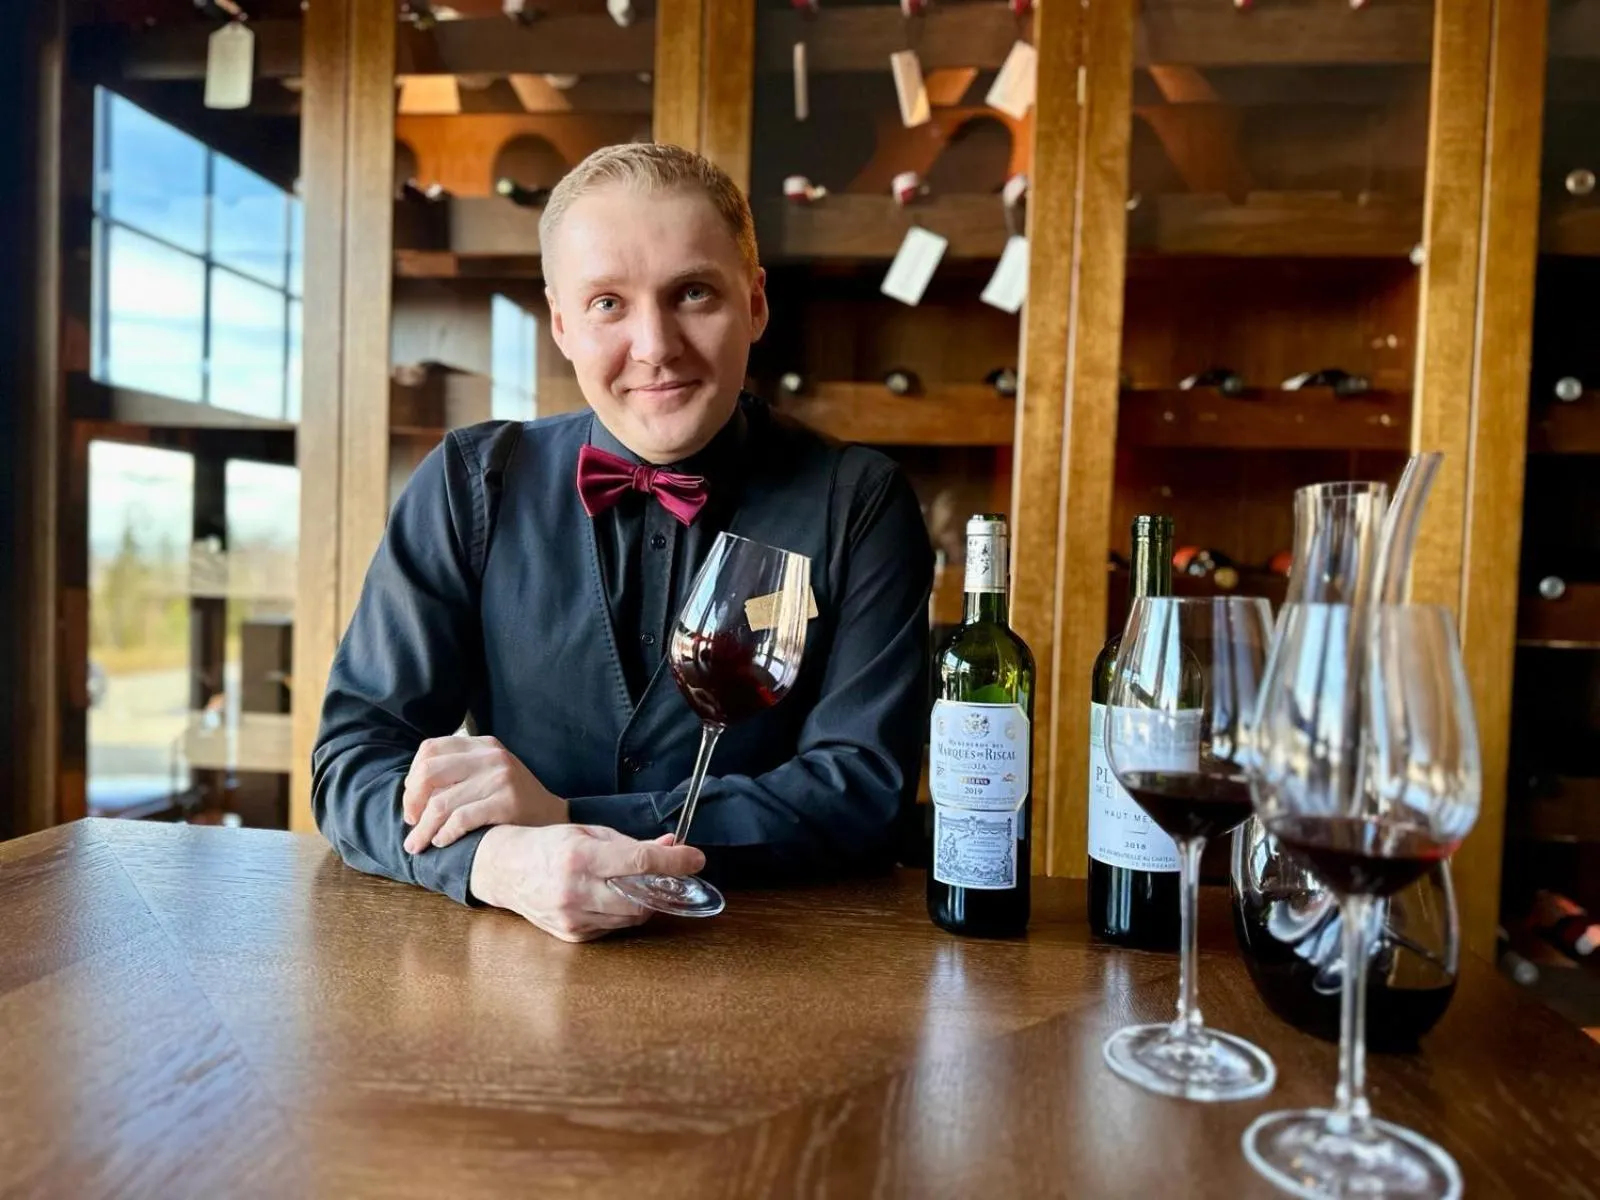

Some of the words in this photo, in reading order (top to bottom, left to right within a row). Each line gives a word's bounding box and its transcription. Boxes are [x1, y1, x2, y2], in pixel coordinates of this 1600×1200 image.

[985, 748, 1016, 760] RISCAL
[1105, 808, 1128, 819] HAUT
[1134, 814, 1154, 824] ME
[1124, 841, 1147, 850] 2018
